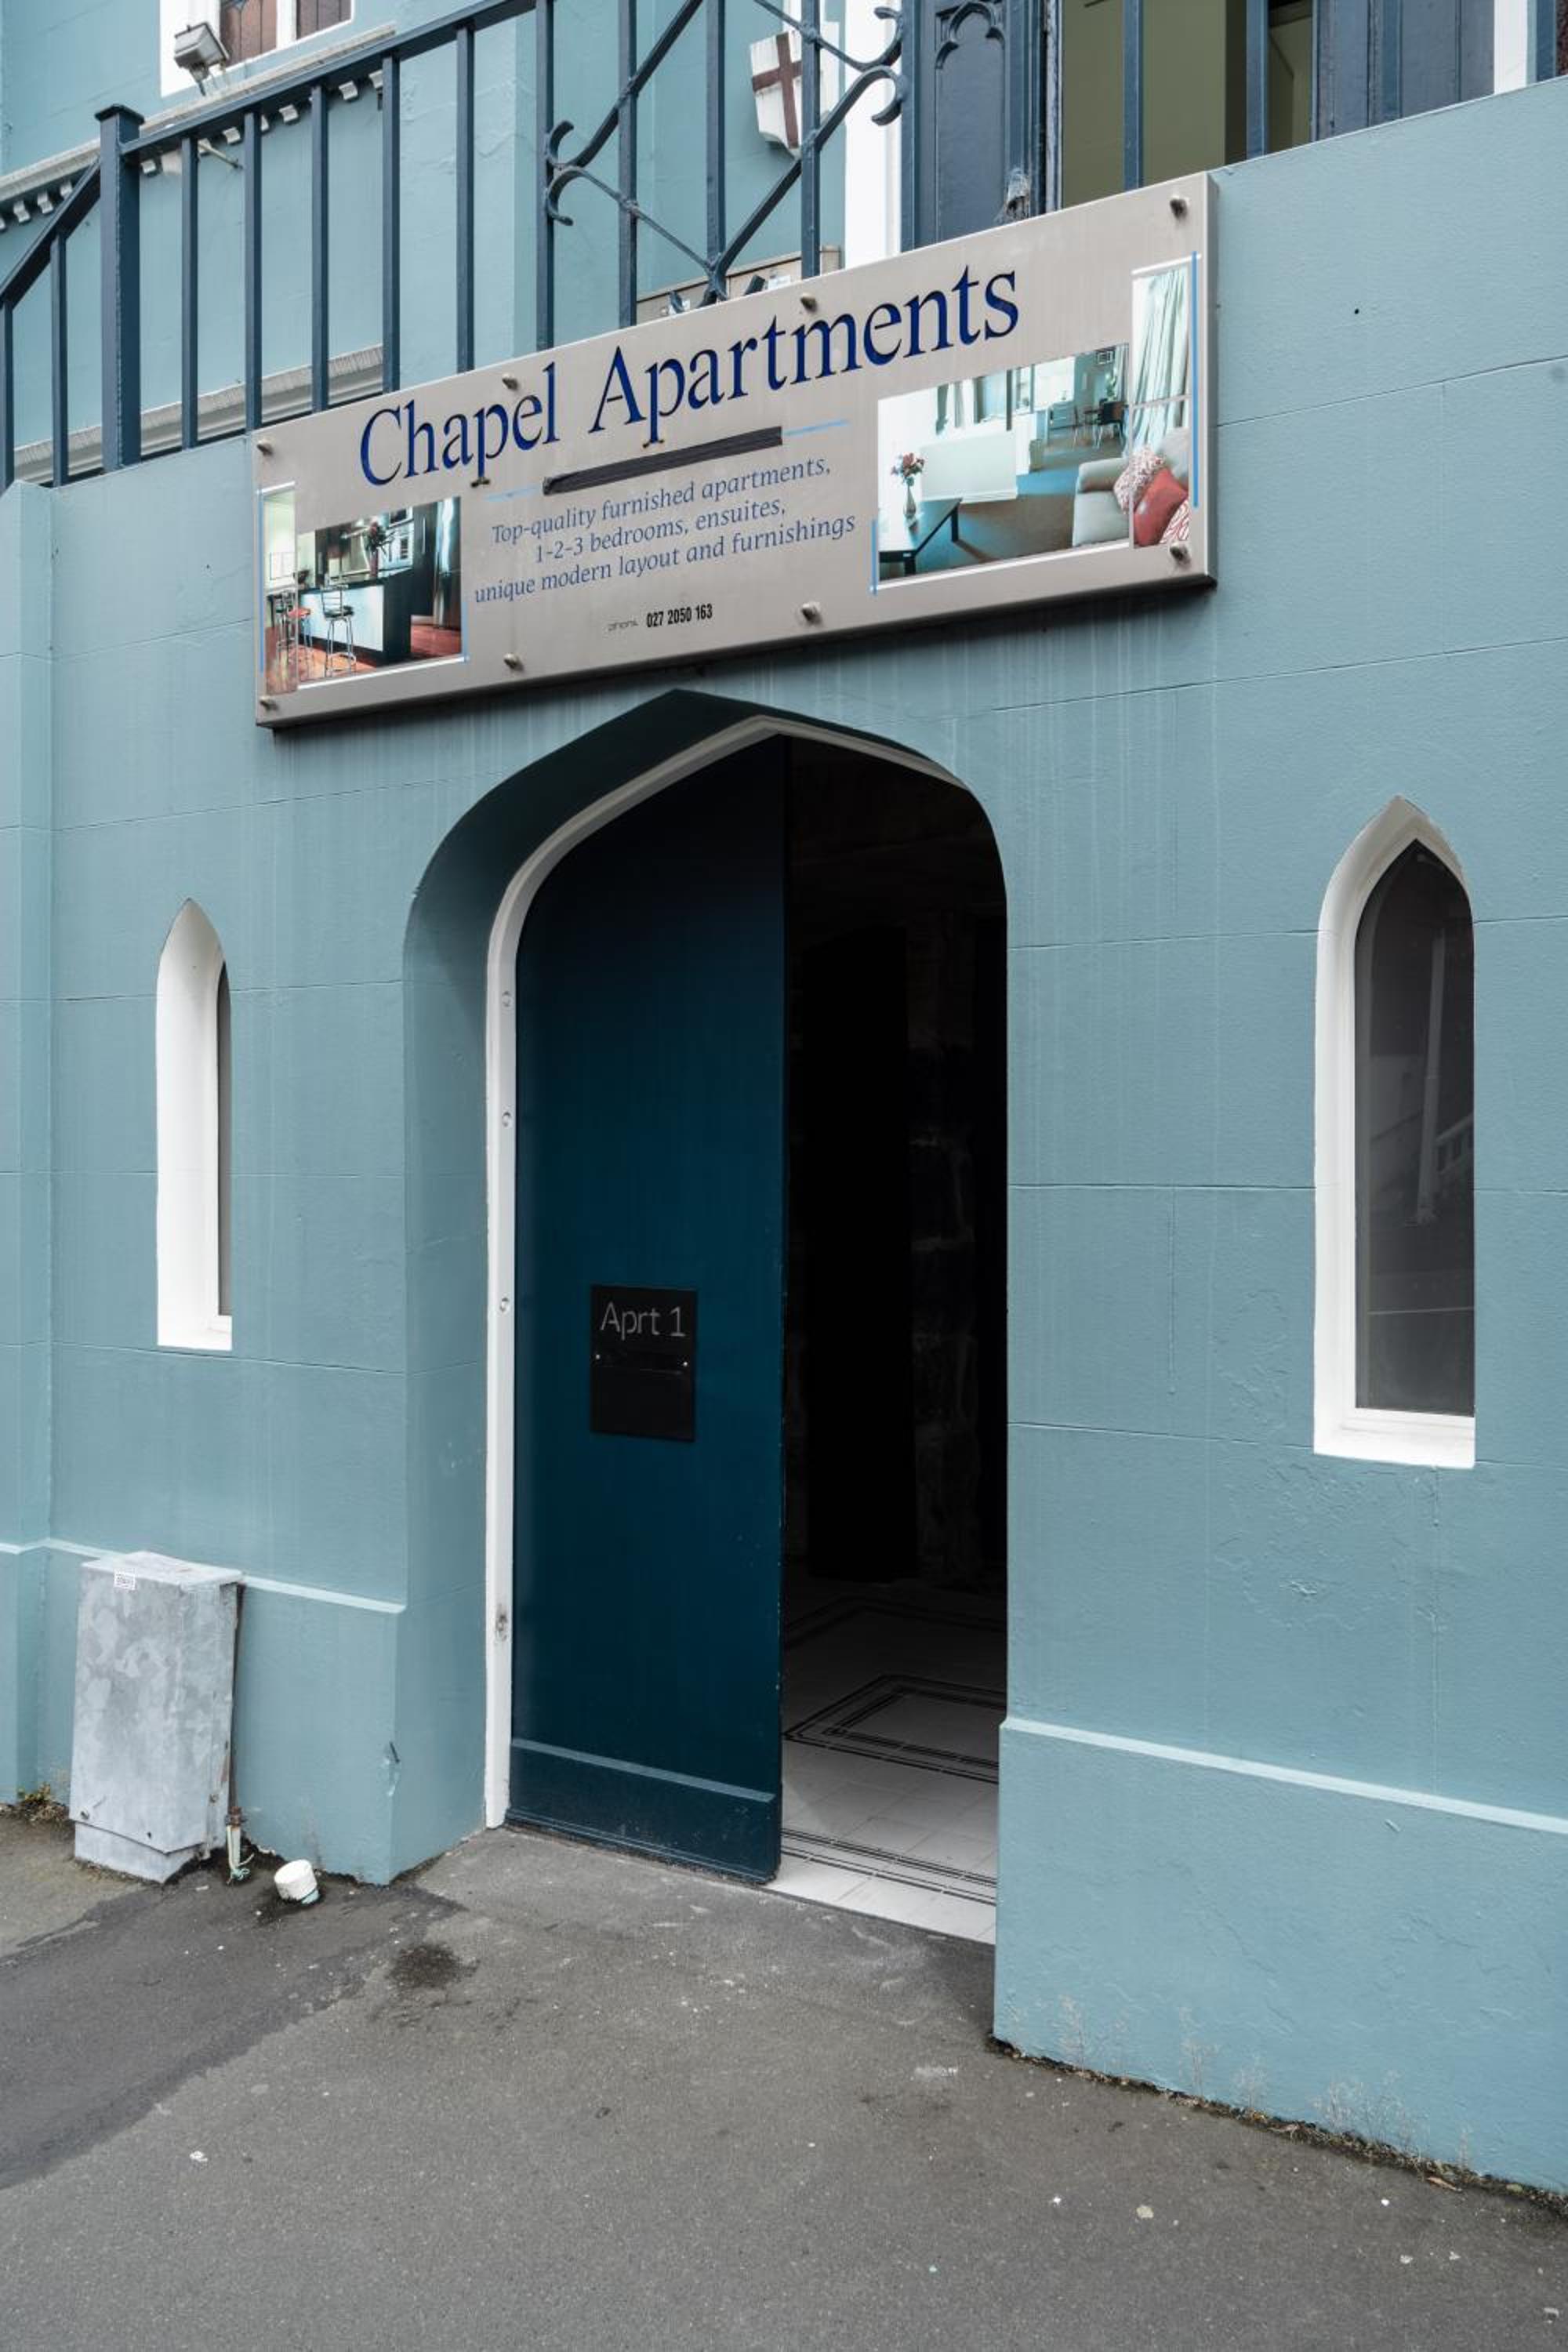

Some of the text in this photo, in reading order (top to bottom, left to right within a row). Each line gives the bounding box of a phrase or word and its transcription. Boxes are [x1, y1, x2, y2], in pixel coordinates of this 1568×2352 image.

[361, 265, 1021, 484] Chapel Apartments
[492, 459, 831, 545] Top-quality furnished apartments,
[536, 499, 786, 563] 1-2-3 bedrooms, ensuites,
[475, 514, 856, 604] unique modern layout and furnishings
[647, 611, 665, 628] 027
[668, 607, 692, 624] 2050
[695, 603, 713, 620] 163
[600, 1301, 687, 1340] Aprt 1
